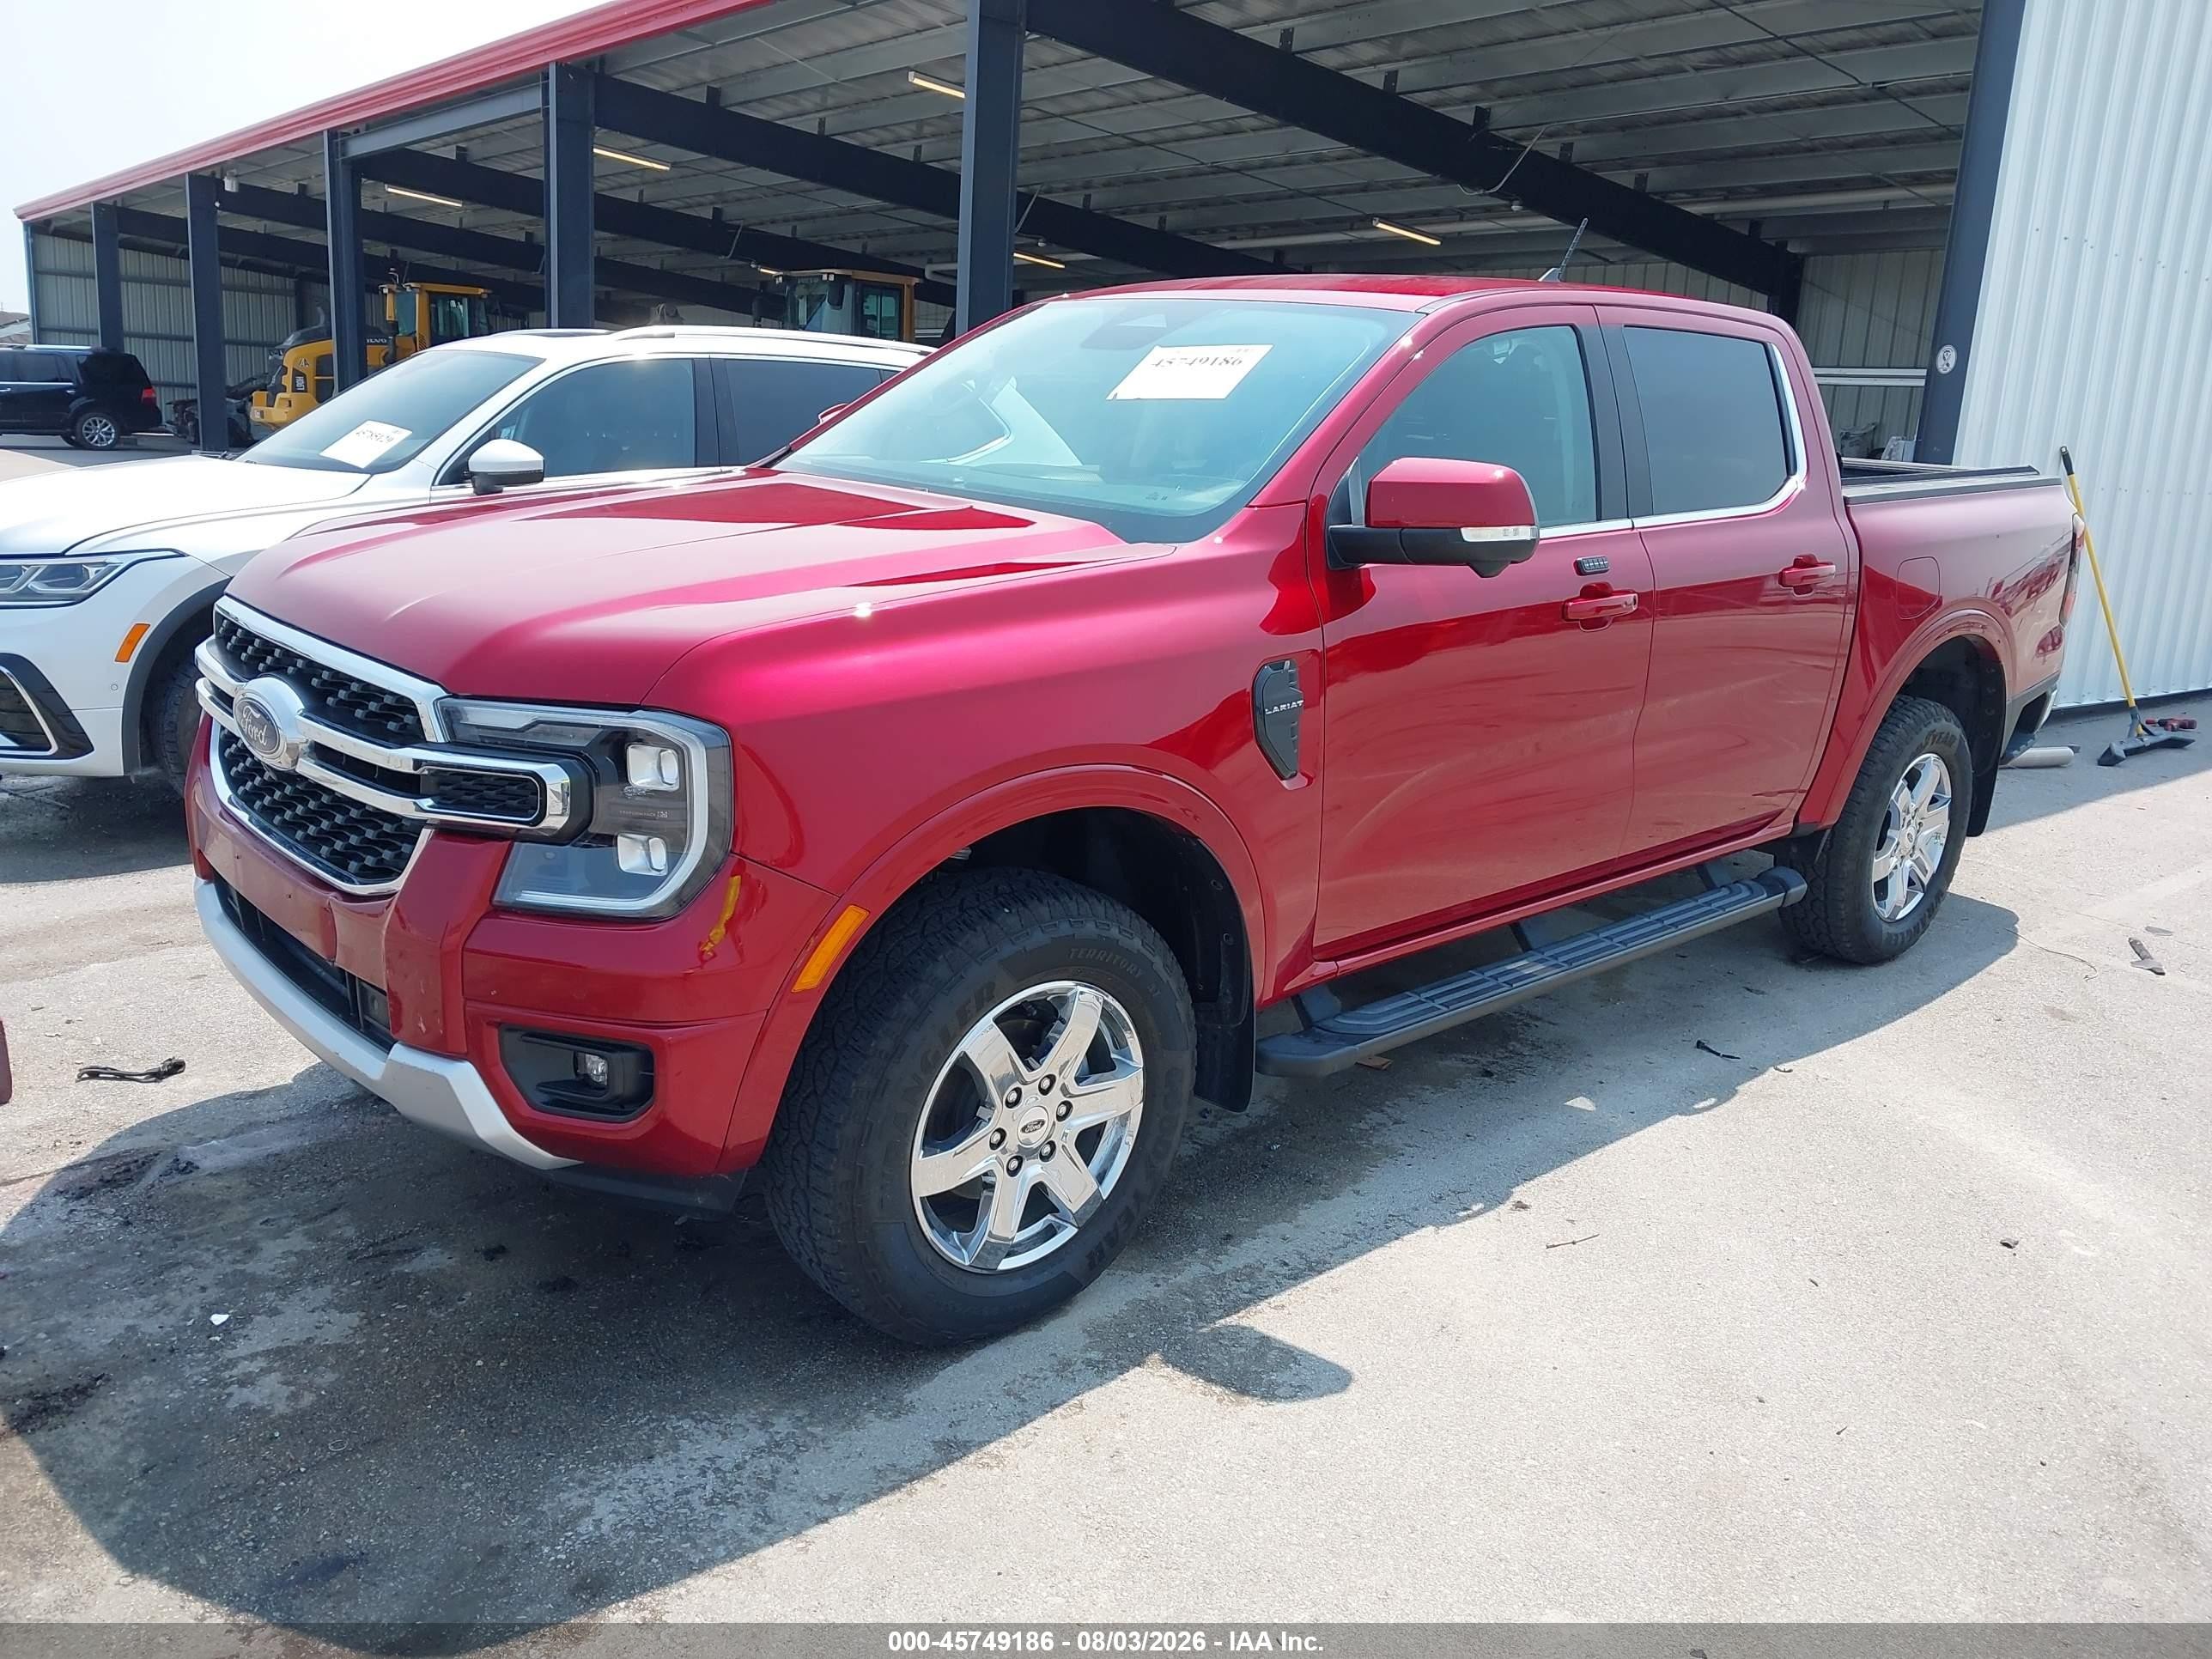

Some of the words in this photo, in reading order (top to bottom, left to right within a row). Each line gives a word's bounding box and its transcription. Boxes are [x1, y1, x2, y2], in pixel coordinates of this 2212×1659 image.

[1265, 700, 1304, 715] LARIAT
[240, 705, 268, 746] Ford
[1069, 947, 1145, 978] TERRITORY
